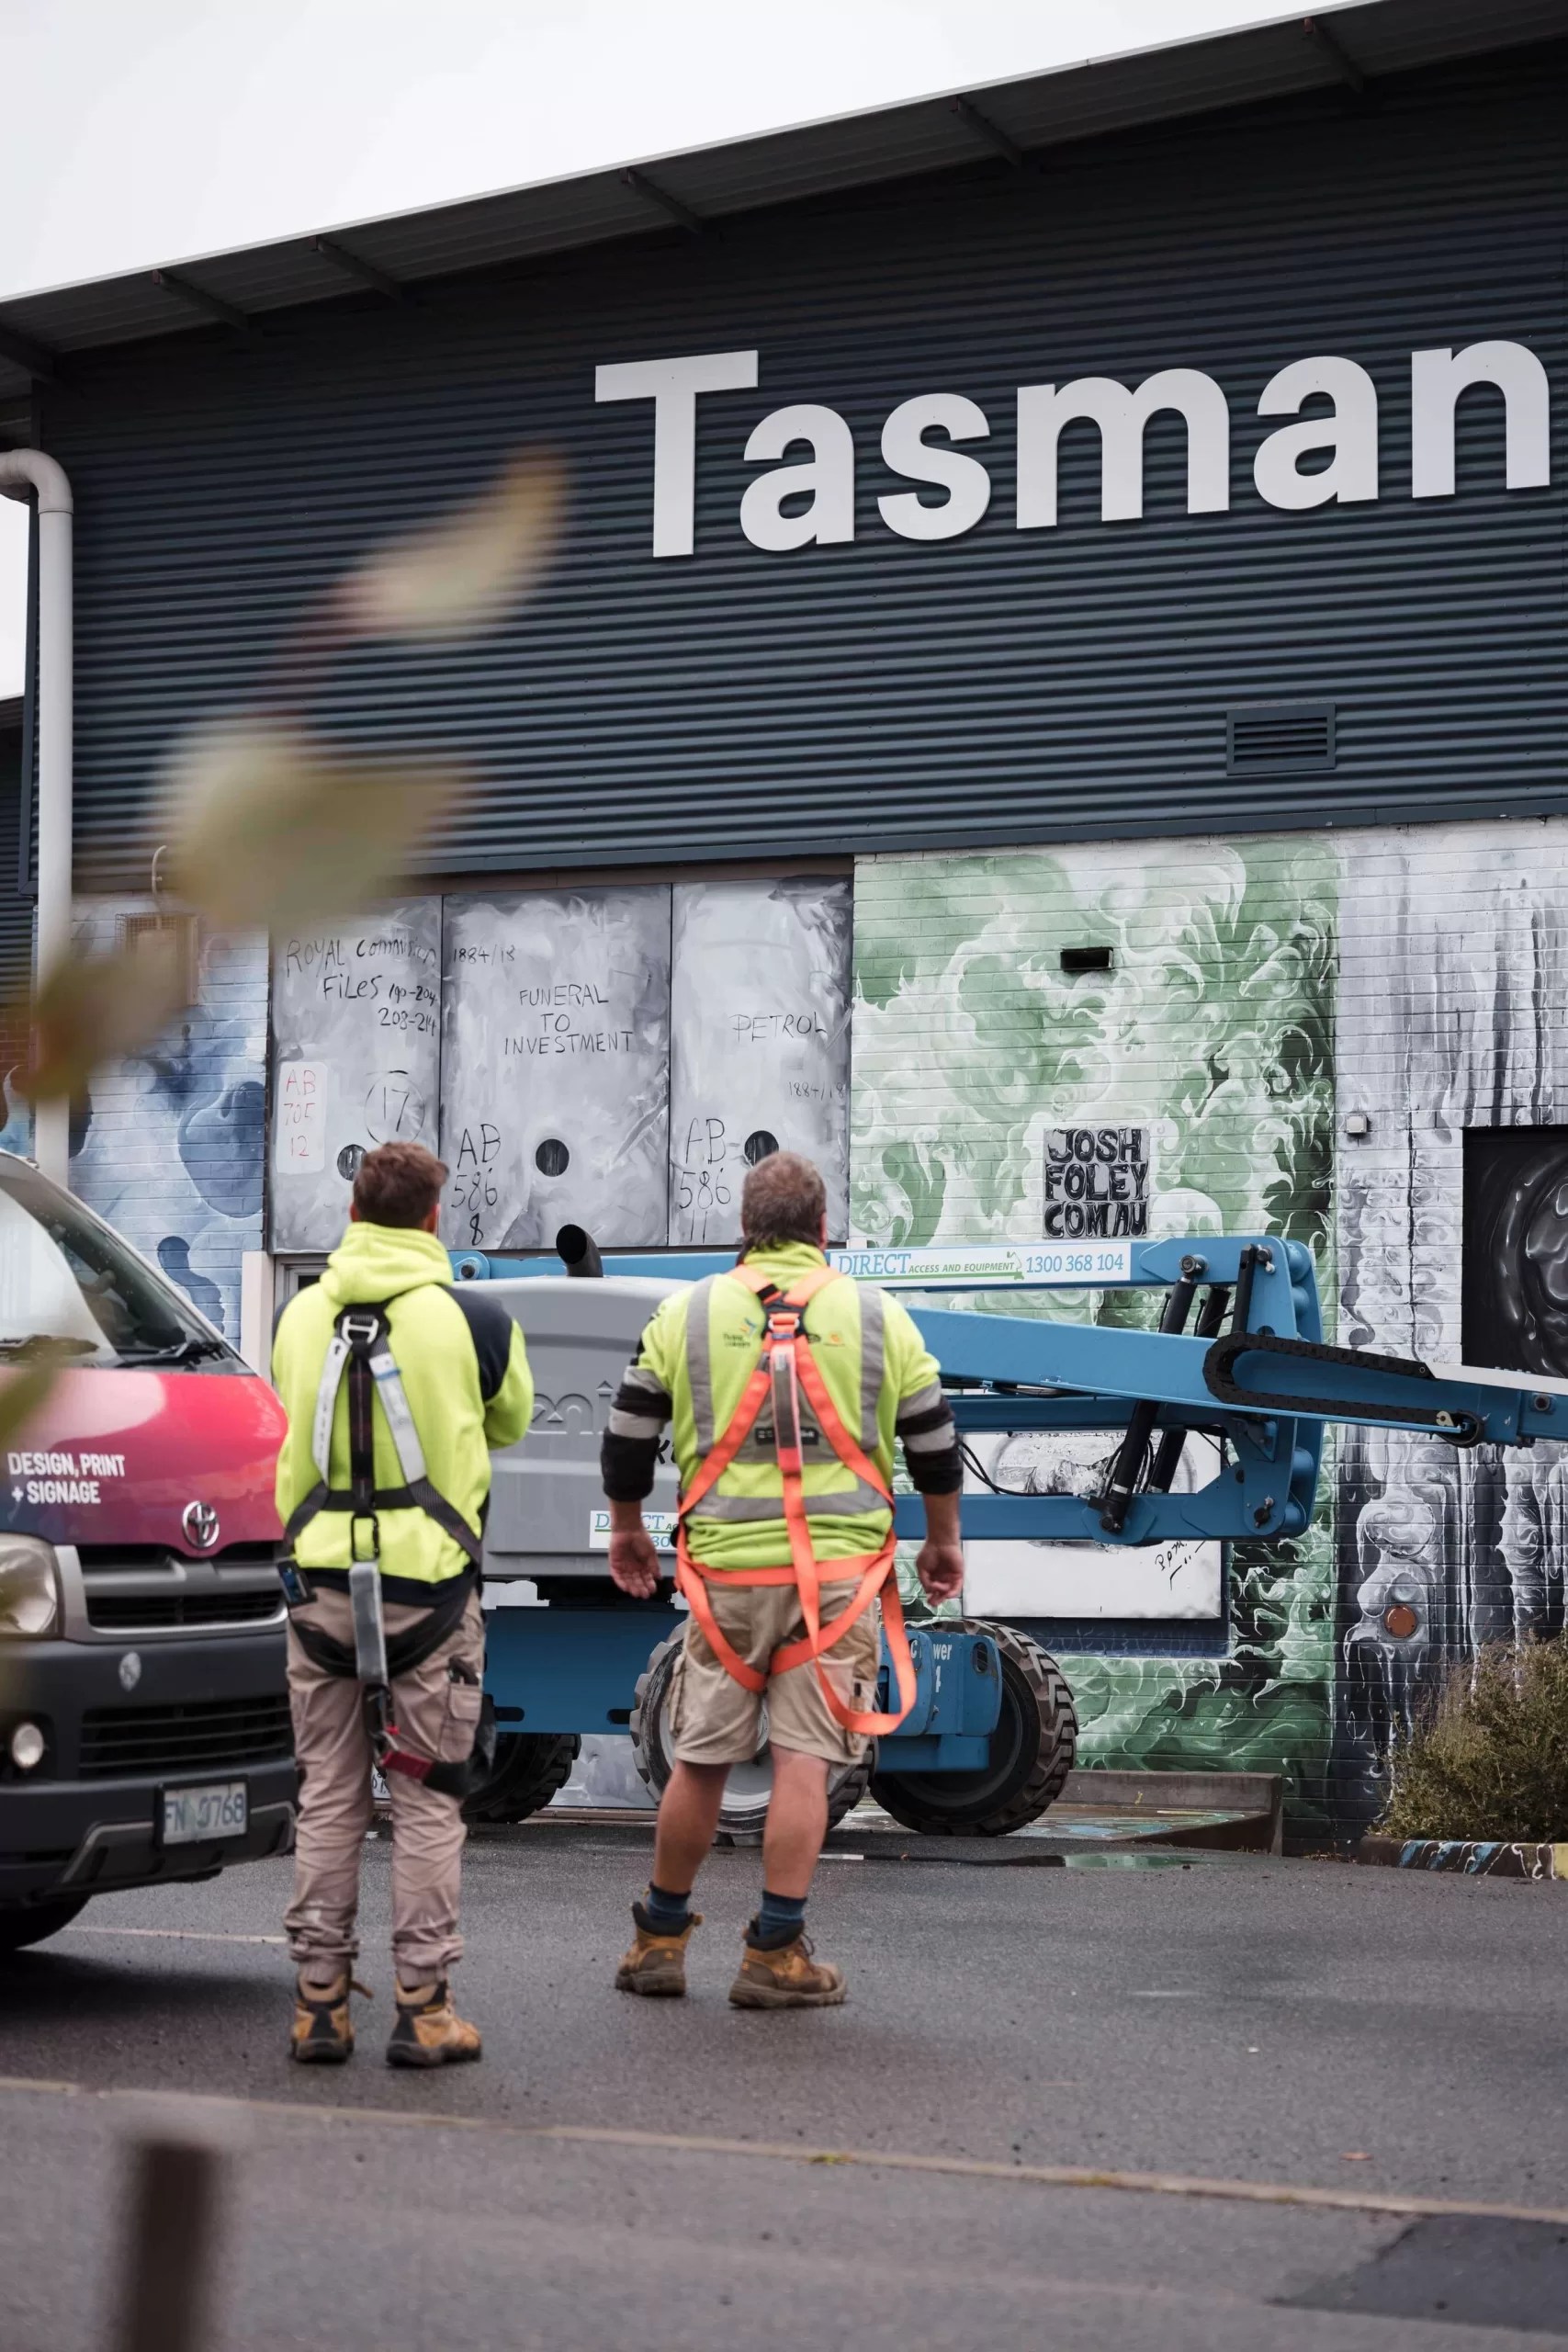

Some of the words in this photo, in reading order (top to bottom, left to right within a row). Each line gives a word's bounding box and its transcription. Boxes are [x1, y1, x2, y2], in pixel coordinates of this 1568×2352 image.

[595, 340, 1551, 558] Tasman
[287, 939, 345, 978] ROYAL
[519, 984, 609, 1007] FUNERAL
[540, 1013, 570, 1033] TO
[729, 1012, 828, 1042] PETROL
[505, 1031, 633, 1056] INVESTMENT
[286, 1069, 317, 1096] AB
[290, 1136, 310, 1157] 12
[457, 1124, 501, 1168] AB
[1048, 1128, 1143, 1163] JOSH
[451, 1168, 498, 1211] 586
[679, 1168, 731, 1209] 586
[469, 1213, 484, 1246] 8
[839, 1253, 911, 1275] DIRECT
[908, 1263, 940, 1273] ACCESS
[942, 1263, 961, 1272] AND
[964, 1261, 1015, 1272] EQUIPMENT
[1026, 1256, 1062, 1273] 1300
[1066, 1254, 1092, 1272] 368
[1097, 1253, 1123, 1271] 104
[79, 1453, 125, 1477] PRINT
[26, 1480, 101, 1504] SIGNAGE
